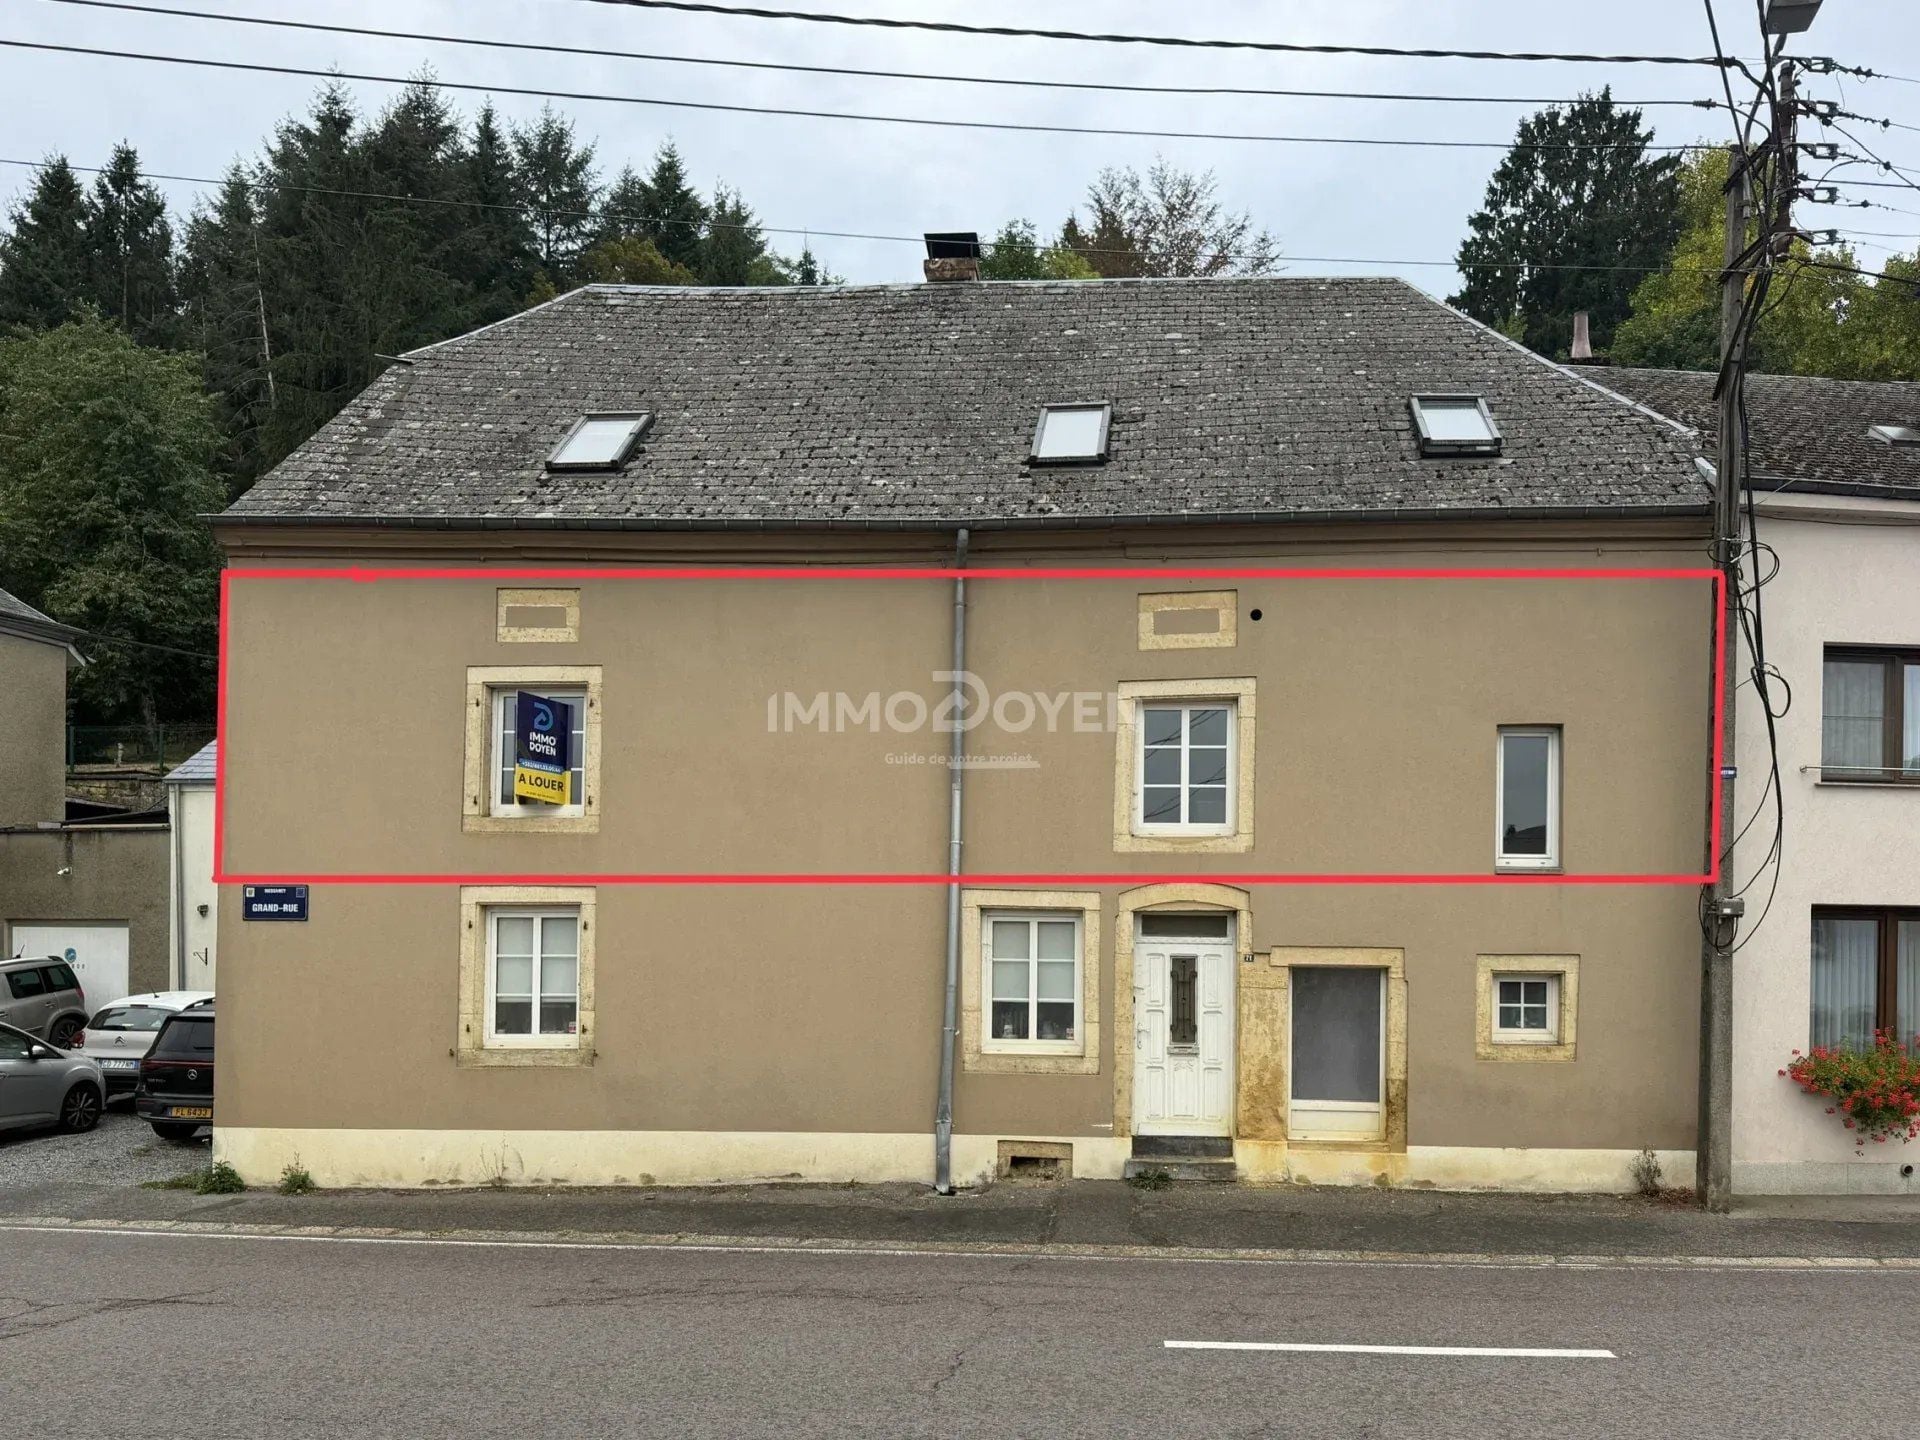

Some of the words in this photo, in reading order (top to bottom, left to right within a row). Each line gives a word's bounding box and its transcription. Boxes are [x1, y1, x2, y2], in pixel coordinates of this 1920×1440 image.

[529, 732, 556, 746] IMMO
[529, 742, 556, 756] DOYEN
[518, 773, 527, 785] A
[529, 775, 564, 792] LOUER
[252, 903, 299, 912] GRAND-RUE
